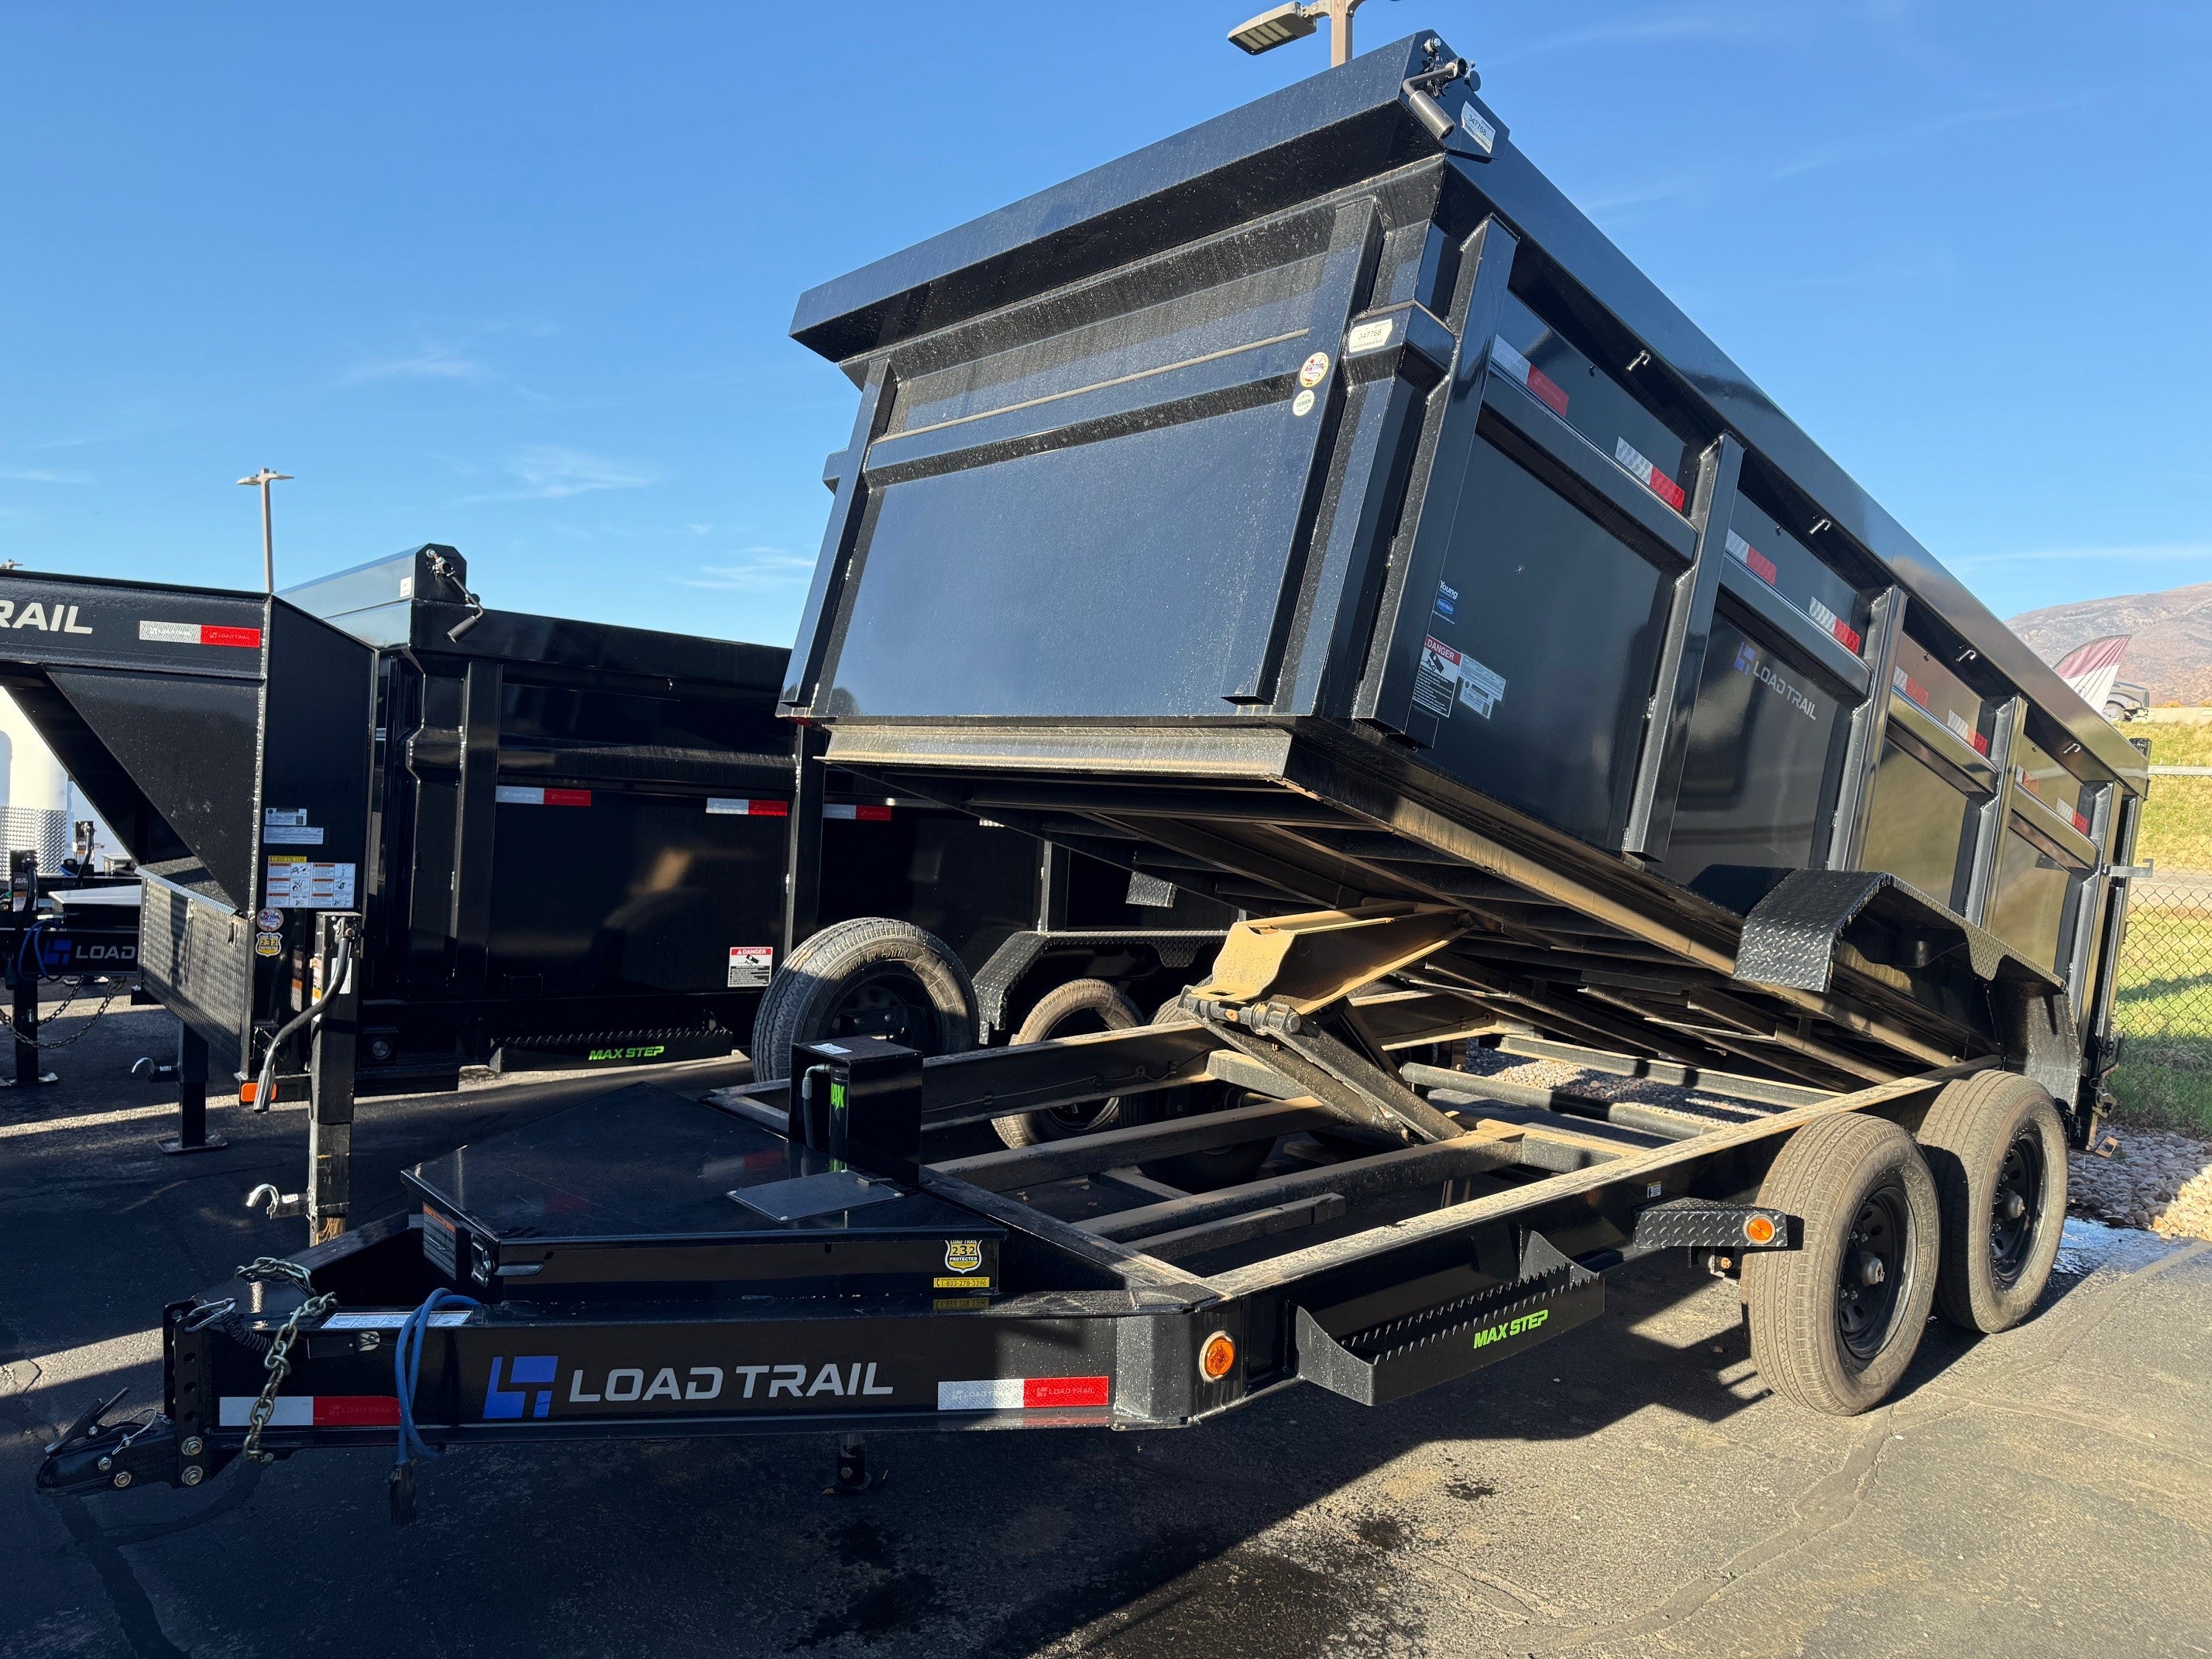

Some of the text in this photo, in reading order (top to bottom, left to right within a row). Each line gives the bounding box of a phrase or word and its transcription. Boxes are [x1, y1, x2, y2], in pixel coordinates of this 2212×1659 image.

[1468, 114, 1487, 136] 347768
[1358, 328, 1382, 340] 347768
[1440, 579, 1458, 600] Young
[1427, 638, 1455, 661] DANGER
[1753, 661, 1786, 695] LOAD
[1787, 685, 1817, 721] TRAIL
[76, 946, 136, 960] LOAD
[588, 1046, 665, 1061] MAX STEP
[830, 1083, 845, 1110] AX
[952, 1245, 975, 1256] 232
[1474, 1309, 1548, 1349] MAX STEP
[569, 1366, 724, 1403] LOAD
[736, 1362, 894, 1399] TRAIL
